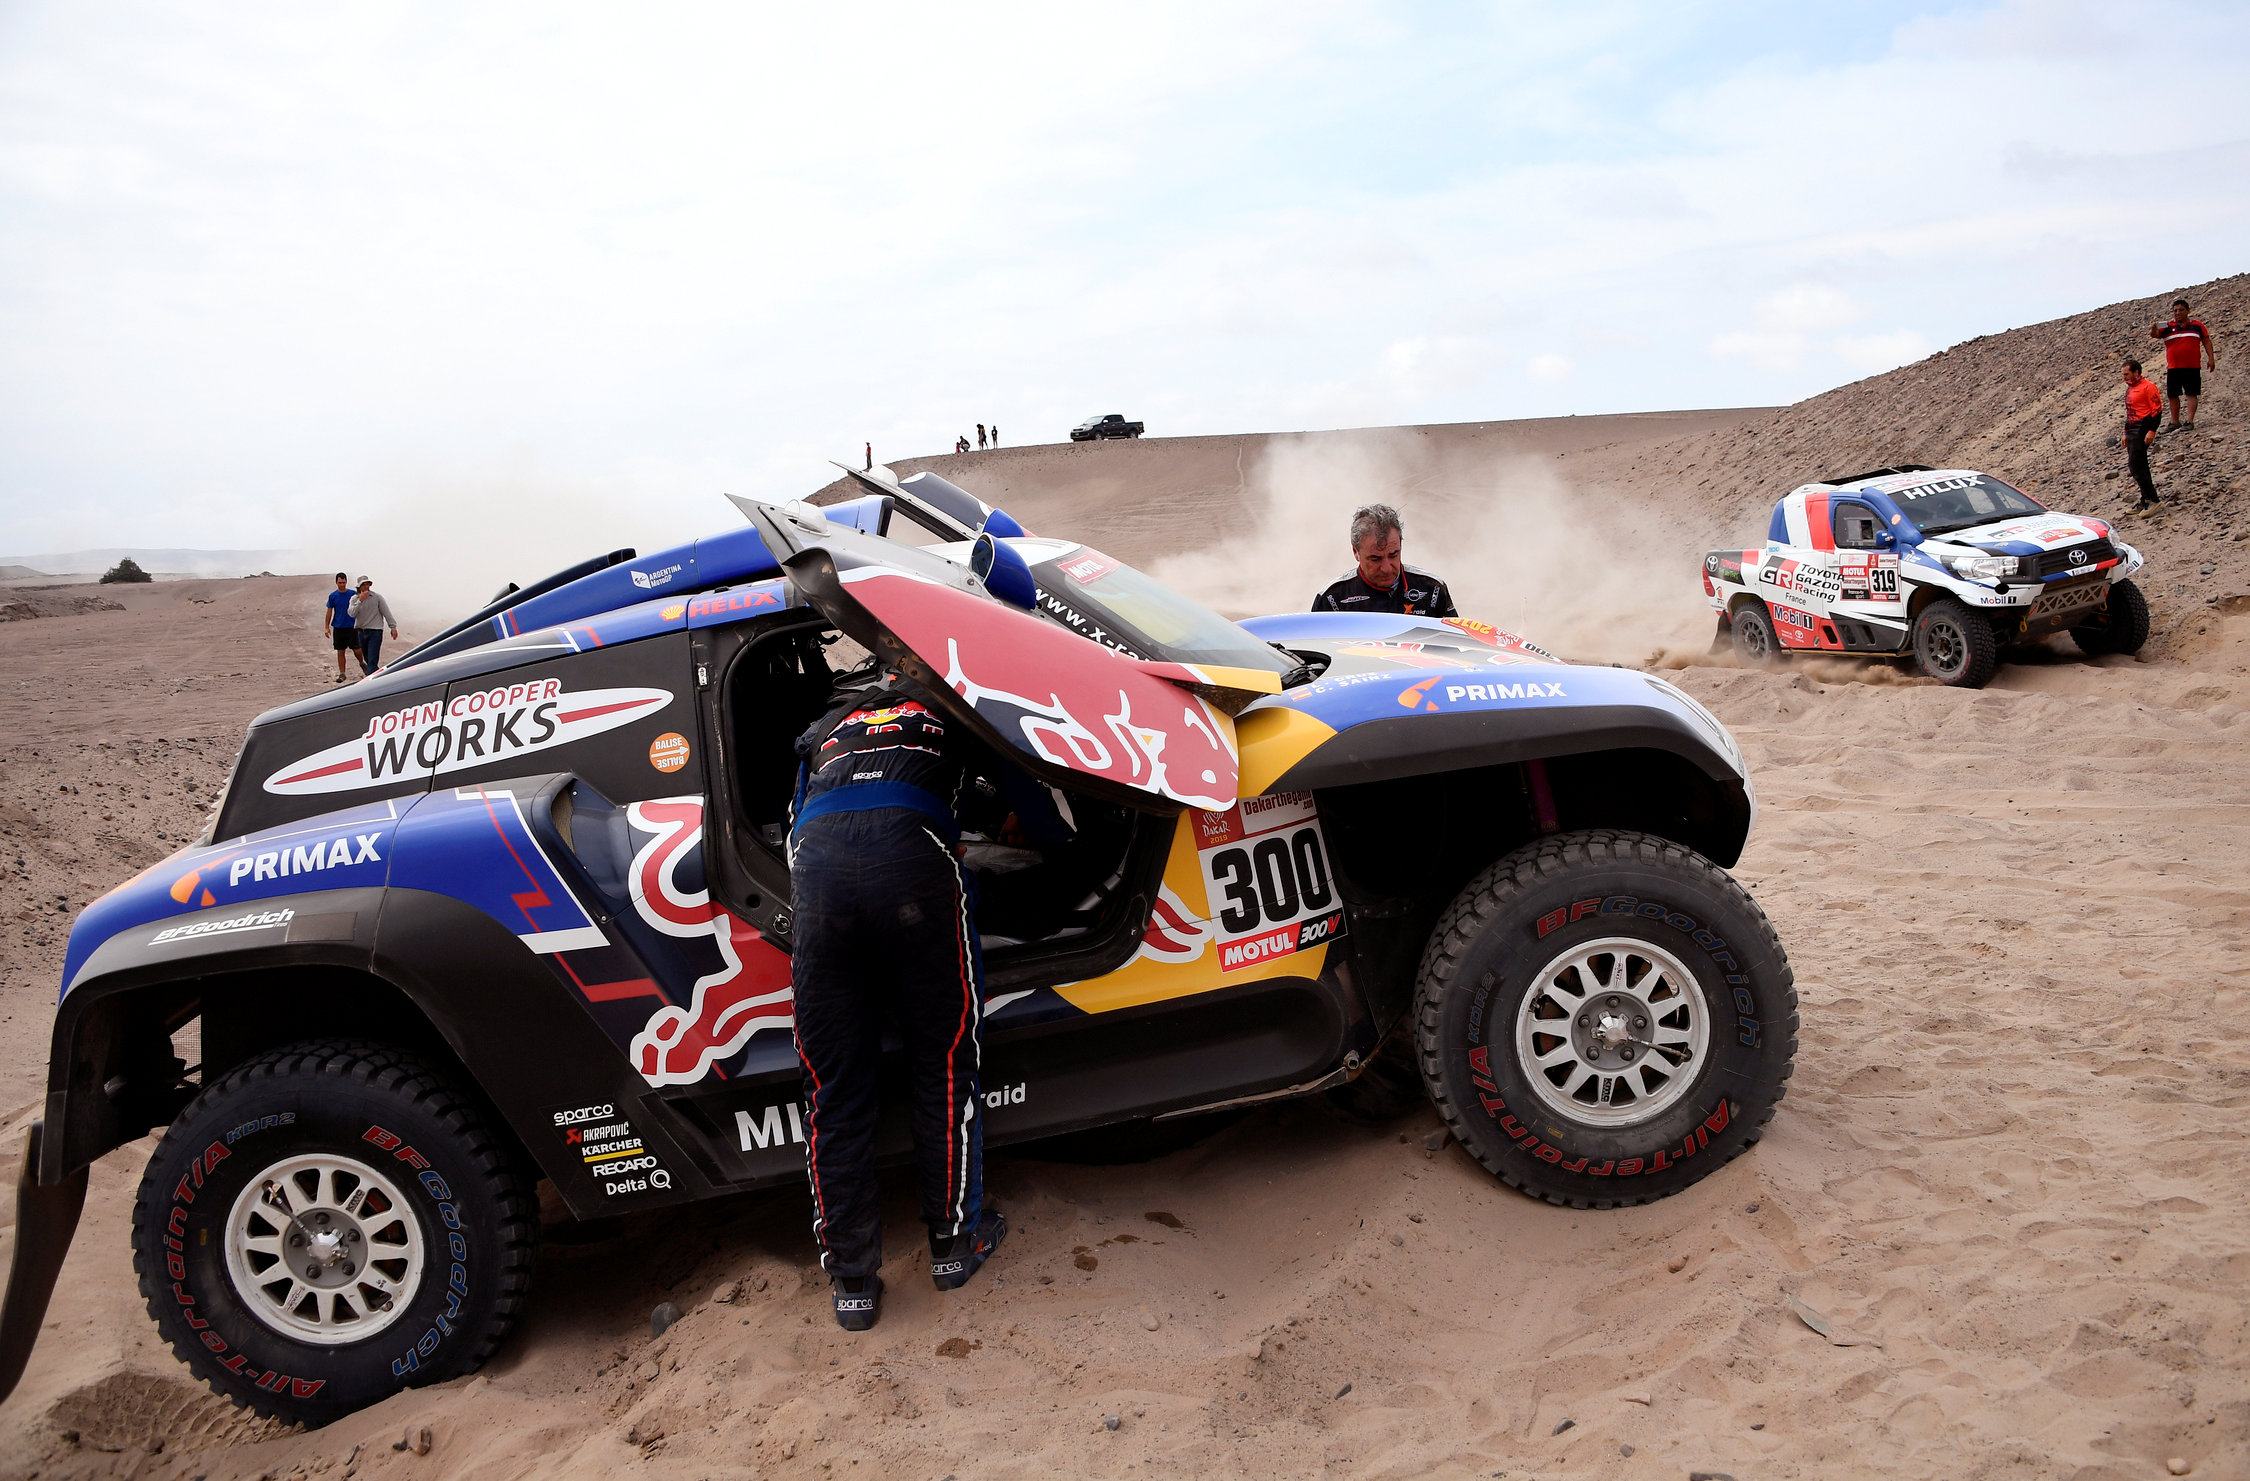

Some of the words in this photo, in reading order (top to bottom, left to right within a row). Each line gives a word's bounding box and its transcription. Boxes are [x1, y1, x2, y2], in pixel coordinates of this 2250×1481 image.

[1902, 476, 1986, 500] HILUX
[649, 564, 682, 580] ARGENTINA
[1796, 573, 1840, 591] GAZOO
[1801, 563, 1845, 582] TOYOTA
[1842, 567, 1866, 576] MOTUL
[1871, 570, 1896, 592] 319
[1785, 592, 1807, 606] France
[1795, 583, 1836, 603] Racing
[1980, 595, 2007, 605] Mobil
[2008, 595, 2016, 605] 1
[689, 591, 777, 618] HELIX
[1774, 604, 1802, 629] Mobil
[1803, 614, 1813, 630] 1
[1338, 673, 1392, 687] SAINZ
[1445, 682, 1567, 702] PRIMAX
[365, 703, 440, 740] JOHN
[451, 680, 559, 718] COOPER
[366, 701, 558, 780] WORKS
[655, 736, 683, 750] BALISE
[656, 755, 685, 769] BALISE
[852, 770, 883, 781] sparco
[1202, 820, 1231, 837] DAKAR
[1210, 834, 1228, 845] 2019
[229, 831, 383, 887] PRIMAX
[1211, 827, 1333, 934] 300
[152, 907, 296, 942] BFGoodrich
[1224, 932, 1294, 967] MOTUL
[1300, 913, 1342, 945] 300V
[1536, 896, 1762, 1049] BFGoodrich
[553, 1102, 614, 1126] sparco
[226, 1112, 296, 1145] KDR2
[1500, 1099, 1730, 1177] All-Terrain
[582, 1138, 643, 1156] KÄRCHER
[592, 1156, 658, 1178] RECARO
[605, 1178, 648, 1196] Delta
[361, 1124, 468, 1377] BFGoodrich
[163, 1206, 328, 1400] All-Terrain
[837, 1298, 873, 1311] sparco
